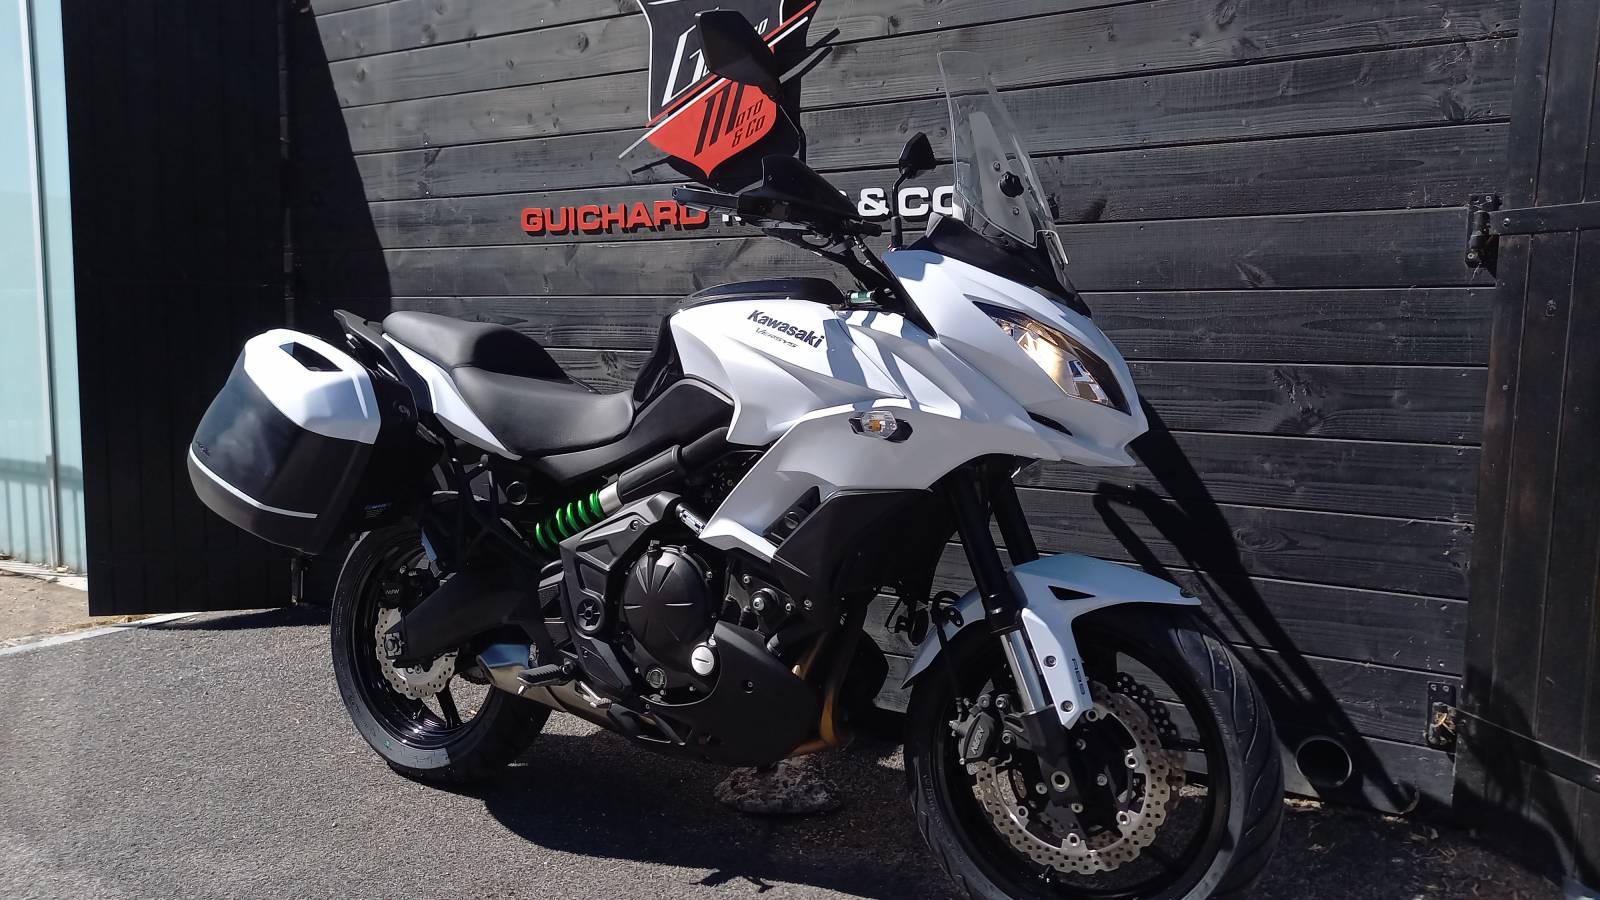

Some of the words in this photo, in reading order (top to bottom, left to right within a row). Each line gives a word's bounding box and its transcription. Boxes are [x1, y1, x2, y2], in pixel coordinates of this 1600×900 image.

[732, 129, 745, 148] &
[519, 200, 707, 232] GUICHARD
[857, 187, 890, 217] &
[746, 309, 825, 349] Kawasaki
